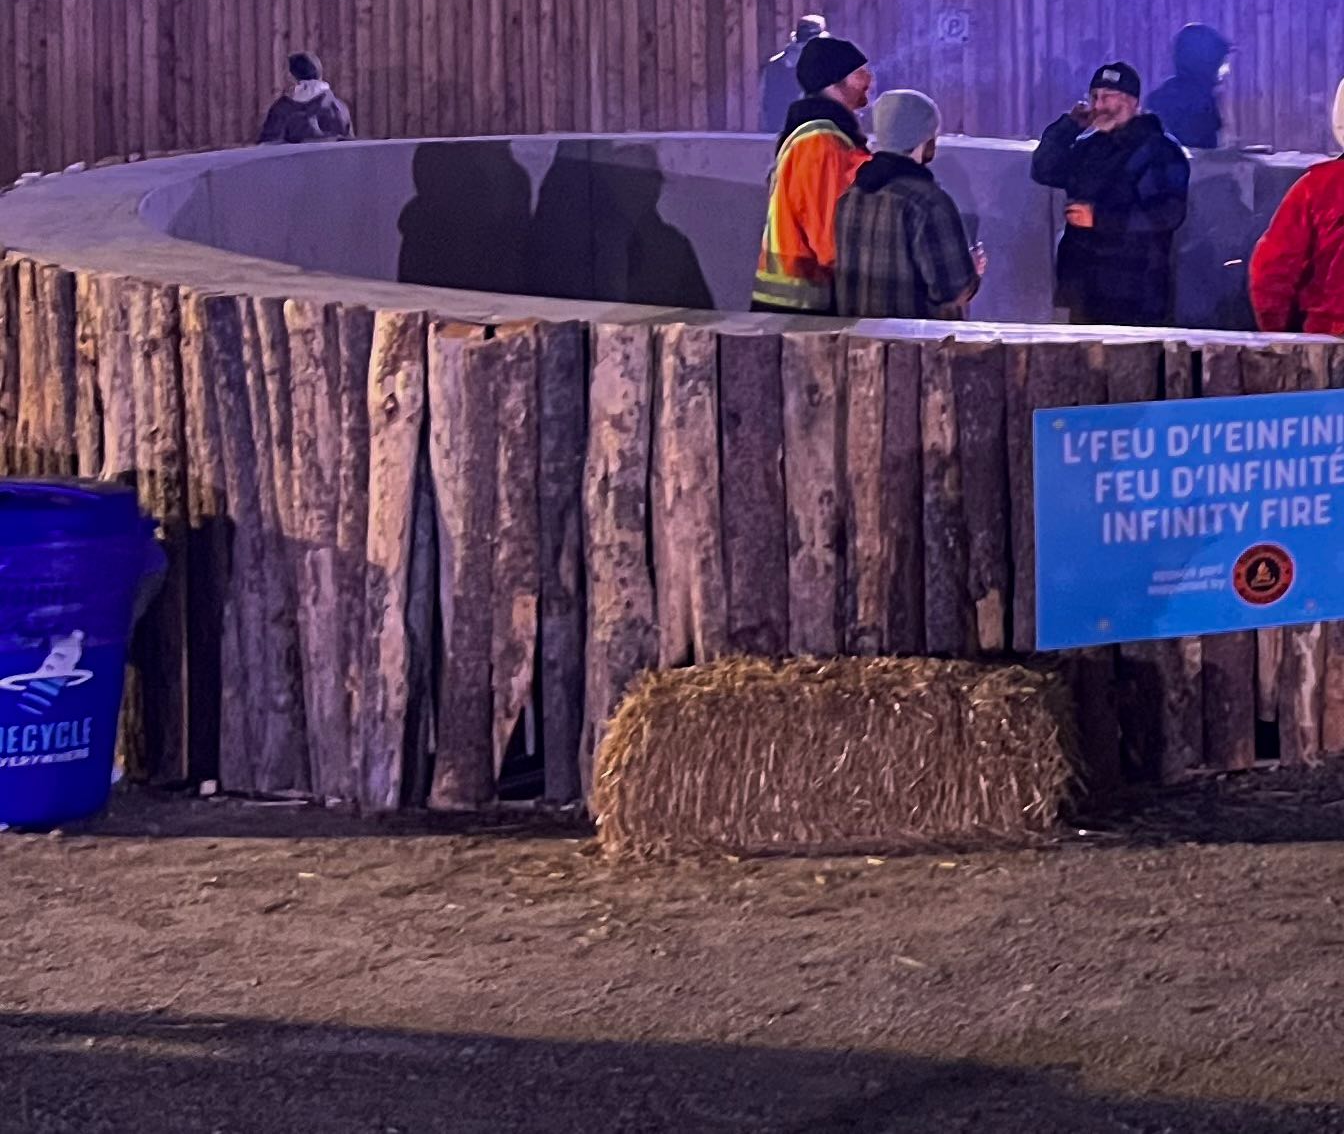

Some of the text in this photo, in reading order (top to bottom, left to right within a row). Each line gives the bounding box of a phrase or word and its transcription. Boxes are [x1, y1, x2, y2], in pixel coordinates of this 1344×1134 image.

[1063, 428, 1155, 464] L'FEU
[1095, 469, 1160, 503] FEU
[1102, 493, 1332, 544] INFINITY FIRE
